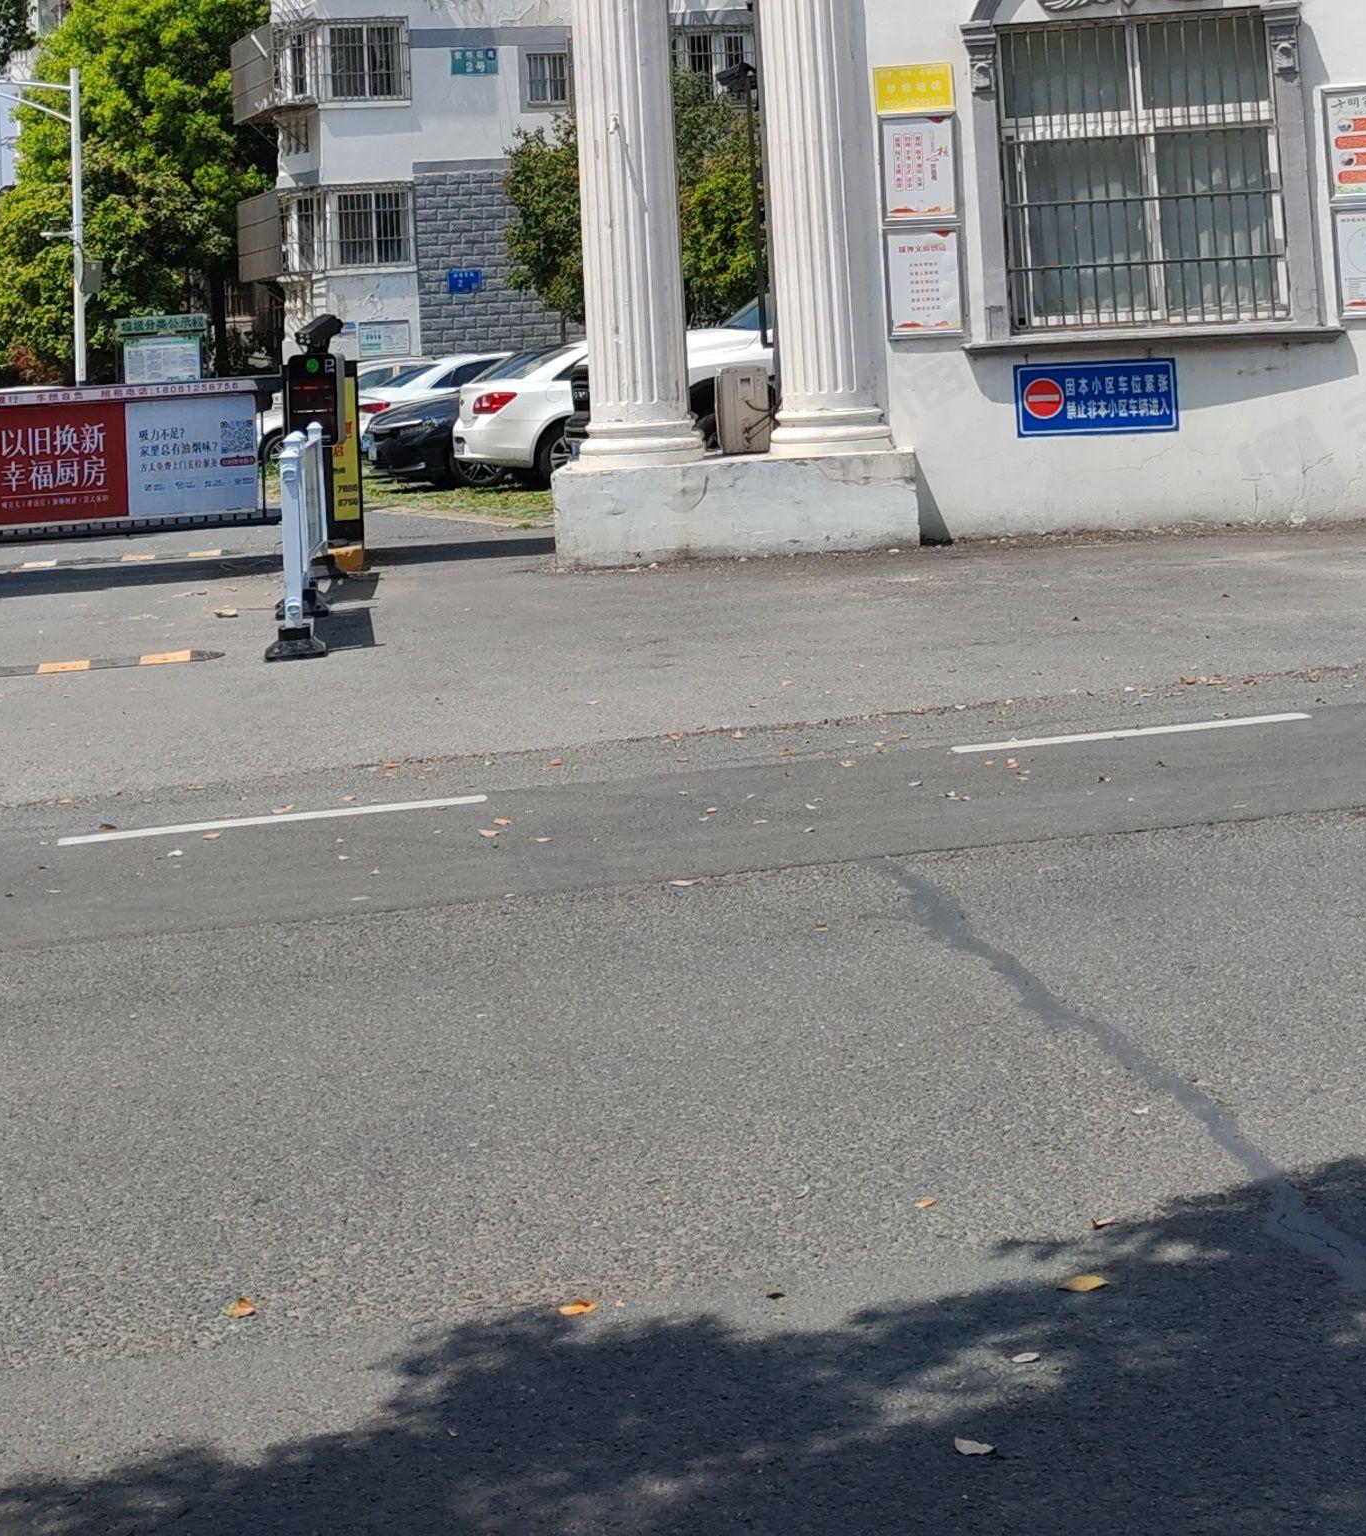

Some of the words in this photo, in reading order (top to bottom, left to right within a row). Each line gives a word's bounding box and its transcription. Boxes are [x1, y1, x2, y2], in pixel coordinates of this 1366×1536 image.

[1064, 373, 1169, 397] 因本小区车位紧张
[1066, 398, 1170, 421] 禁止非本小区车辆进入
[1, 422, 107, 459] 以旧换新
[1, 455, 108, 493] 幸福厨房
